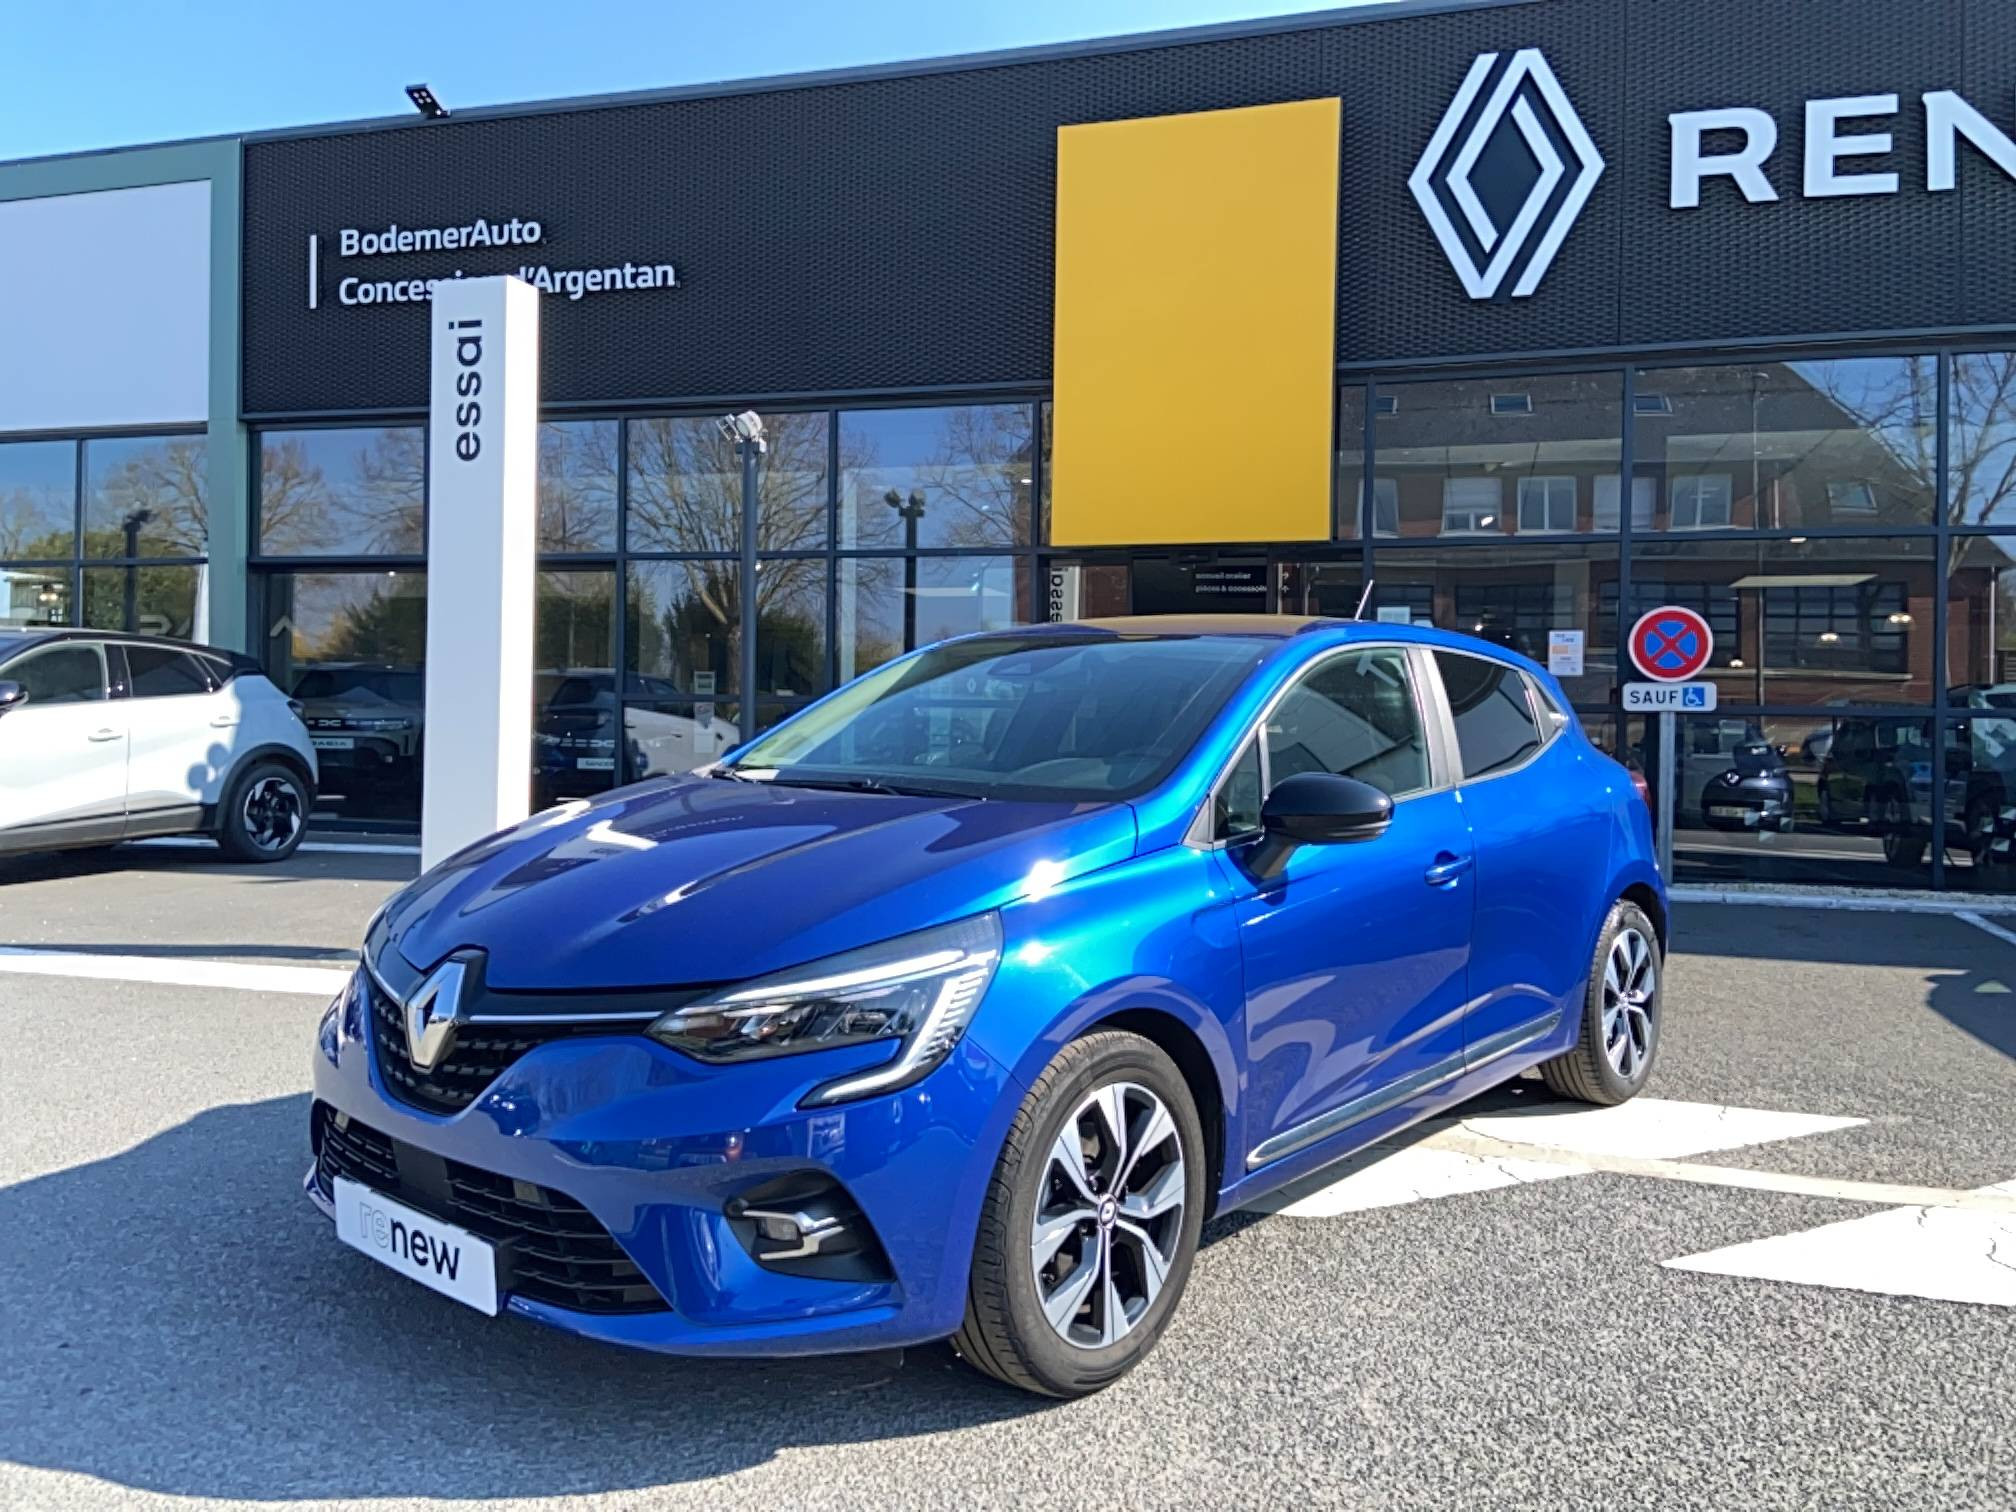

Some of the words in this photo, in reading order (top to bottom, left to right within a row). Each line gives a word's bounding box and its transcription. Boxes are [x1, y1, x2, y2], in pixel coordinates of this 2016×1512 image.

[1667, 89, 2016, 209] REN
[340, 218, 542, 257] BodemerAuto
[448, 319, 483, 462] essai
[1629, 690, 1680, 705] SAUF
[359, 1201, 461, 1281] renew
